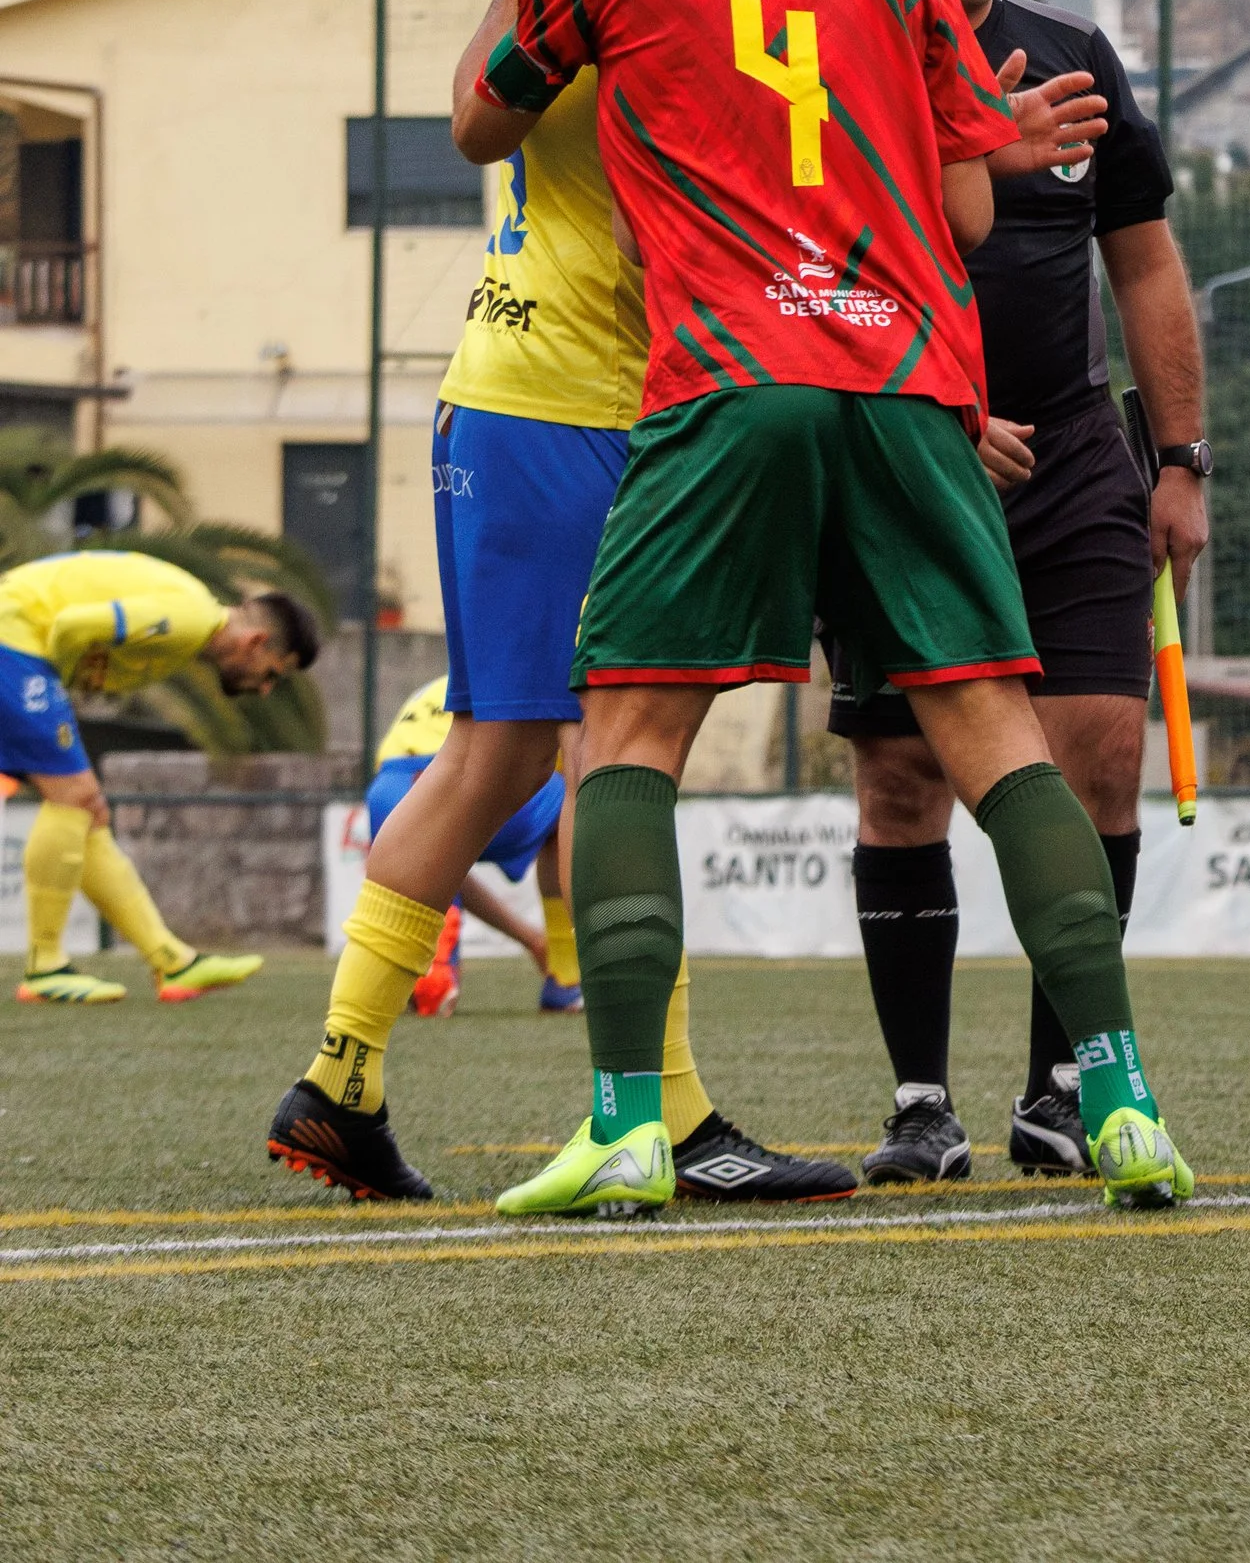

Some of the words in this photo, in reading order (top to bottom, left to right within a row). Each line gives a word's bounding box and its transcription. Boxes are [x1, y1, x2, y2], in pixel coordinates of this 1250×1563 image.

[818, 289, 882, 298] MUNICIPAL
[833, 299, 898, 313] TIRSO
[702, 852, 827, 887] SANTO
